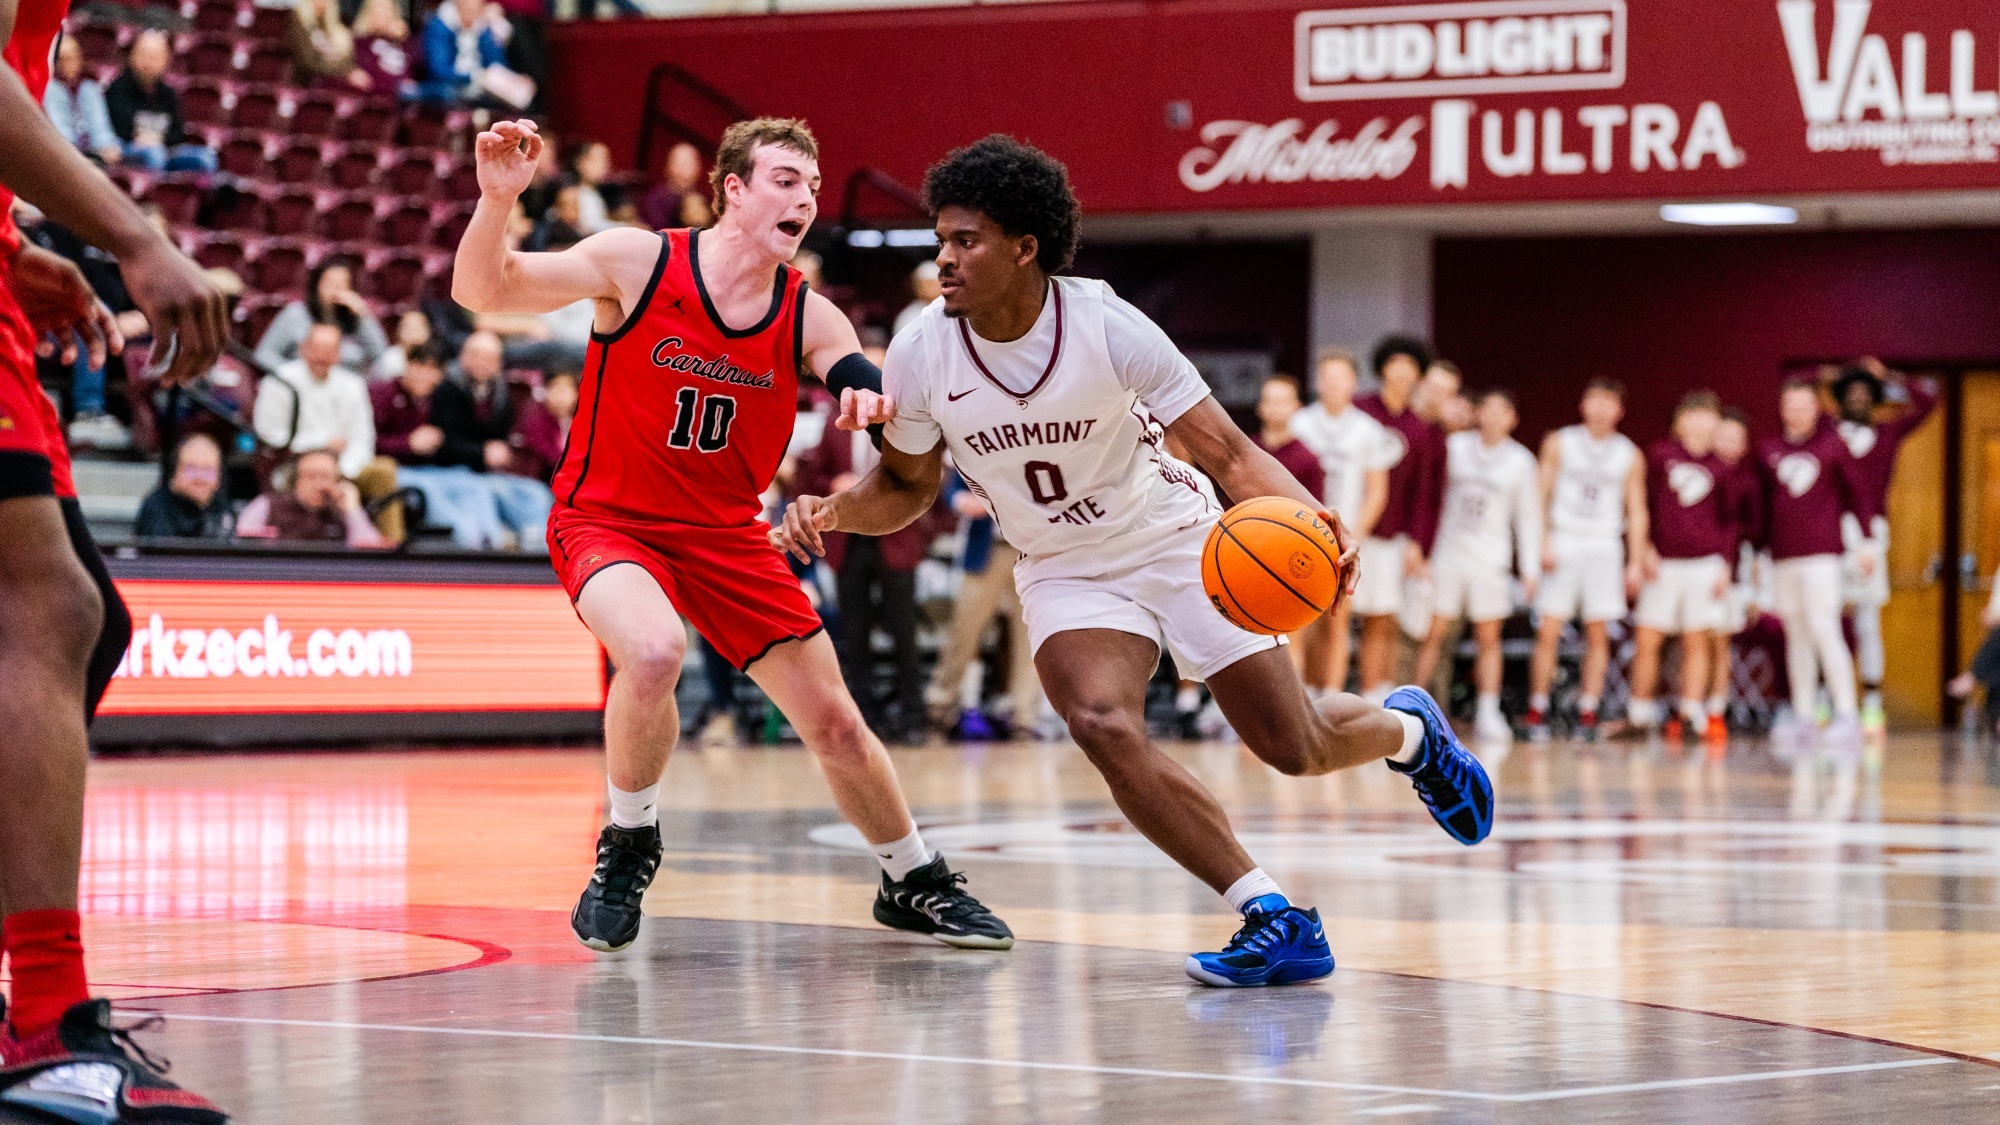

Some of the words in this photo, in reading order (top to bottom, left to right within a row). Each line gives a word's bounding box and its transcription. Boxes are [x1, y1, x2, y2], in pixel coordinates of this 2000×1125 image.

[1311, 24, 1434, 83] BUD
[1435, 14, 1611, 77] LIGHT
[1178, 114, 1425, 192] Michelob
[1482, 100, 1738, 177] ULTRA
[667, 386, 738, 454] 10
[964, 418, 1098, 456] FAIRMONT
[1024, 460, 1068, 505] 0
